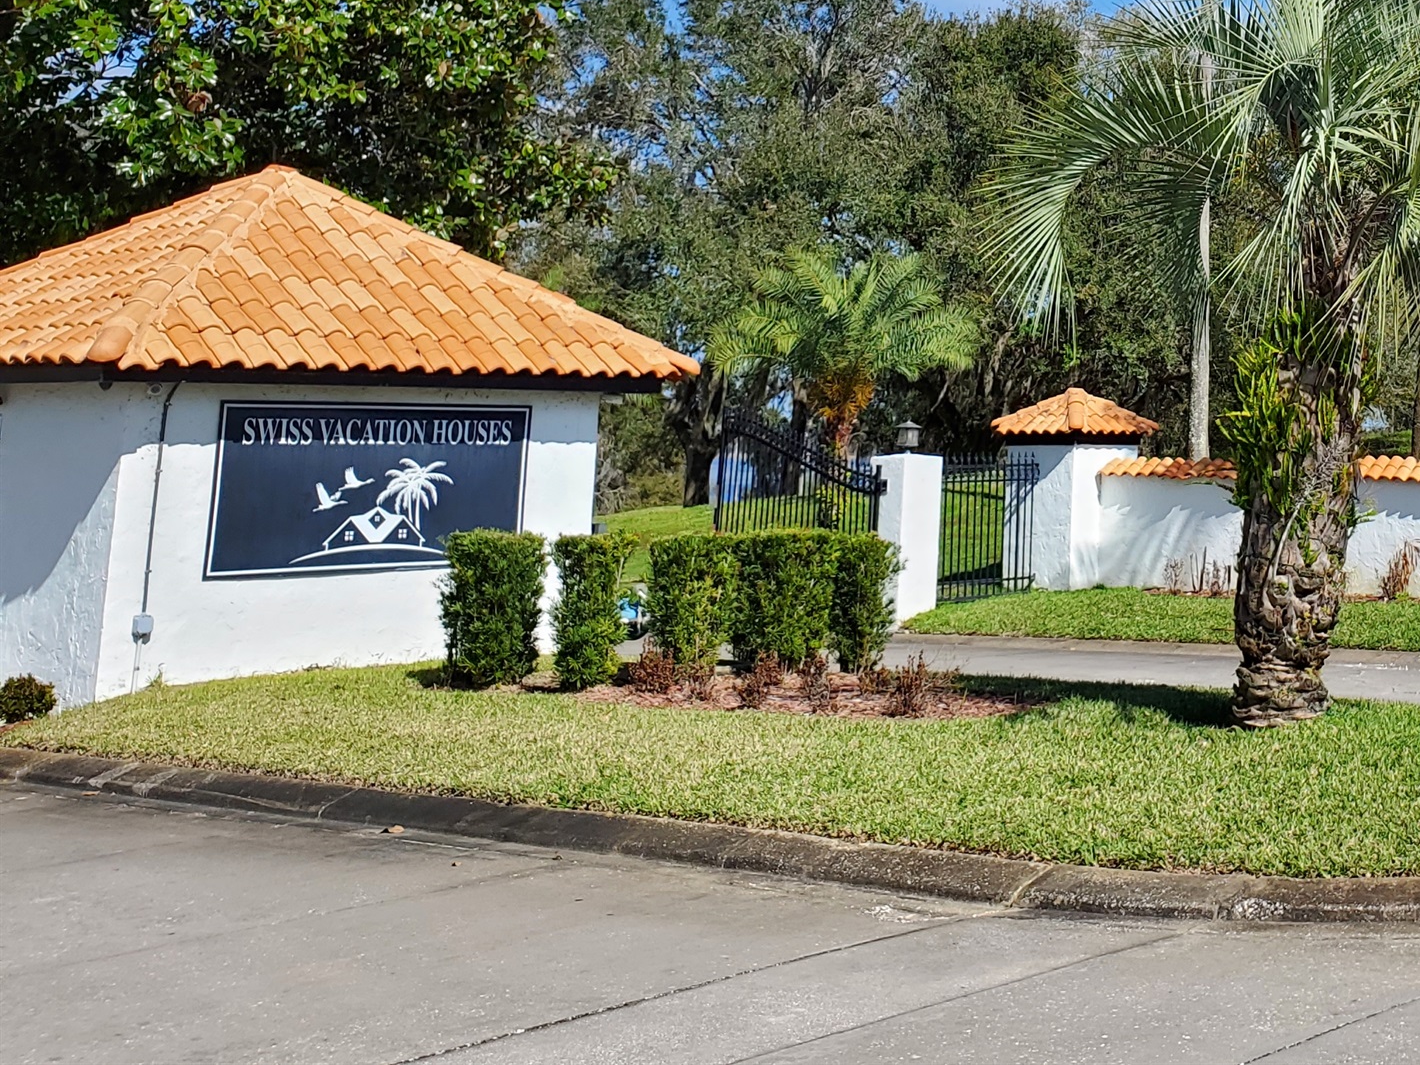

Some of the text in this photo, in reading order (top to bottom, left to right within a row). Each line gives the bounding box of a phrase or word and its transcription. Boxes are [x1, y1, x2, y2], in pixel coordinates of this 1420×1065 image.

[241, 417, 513, 446] SWISS VACATION HOUSES
